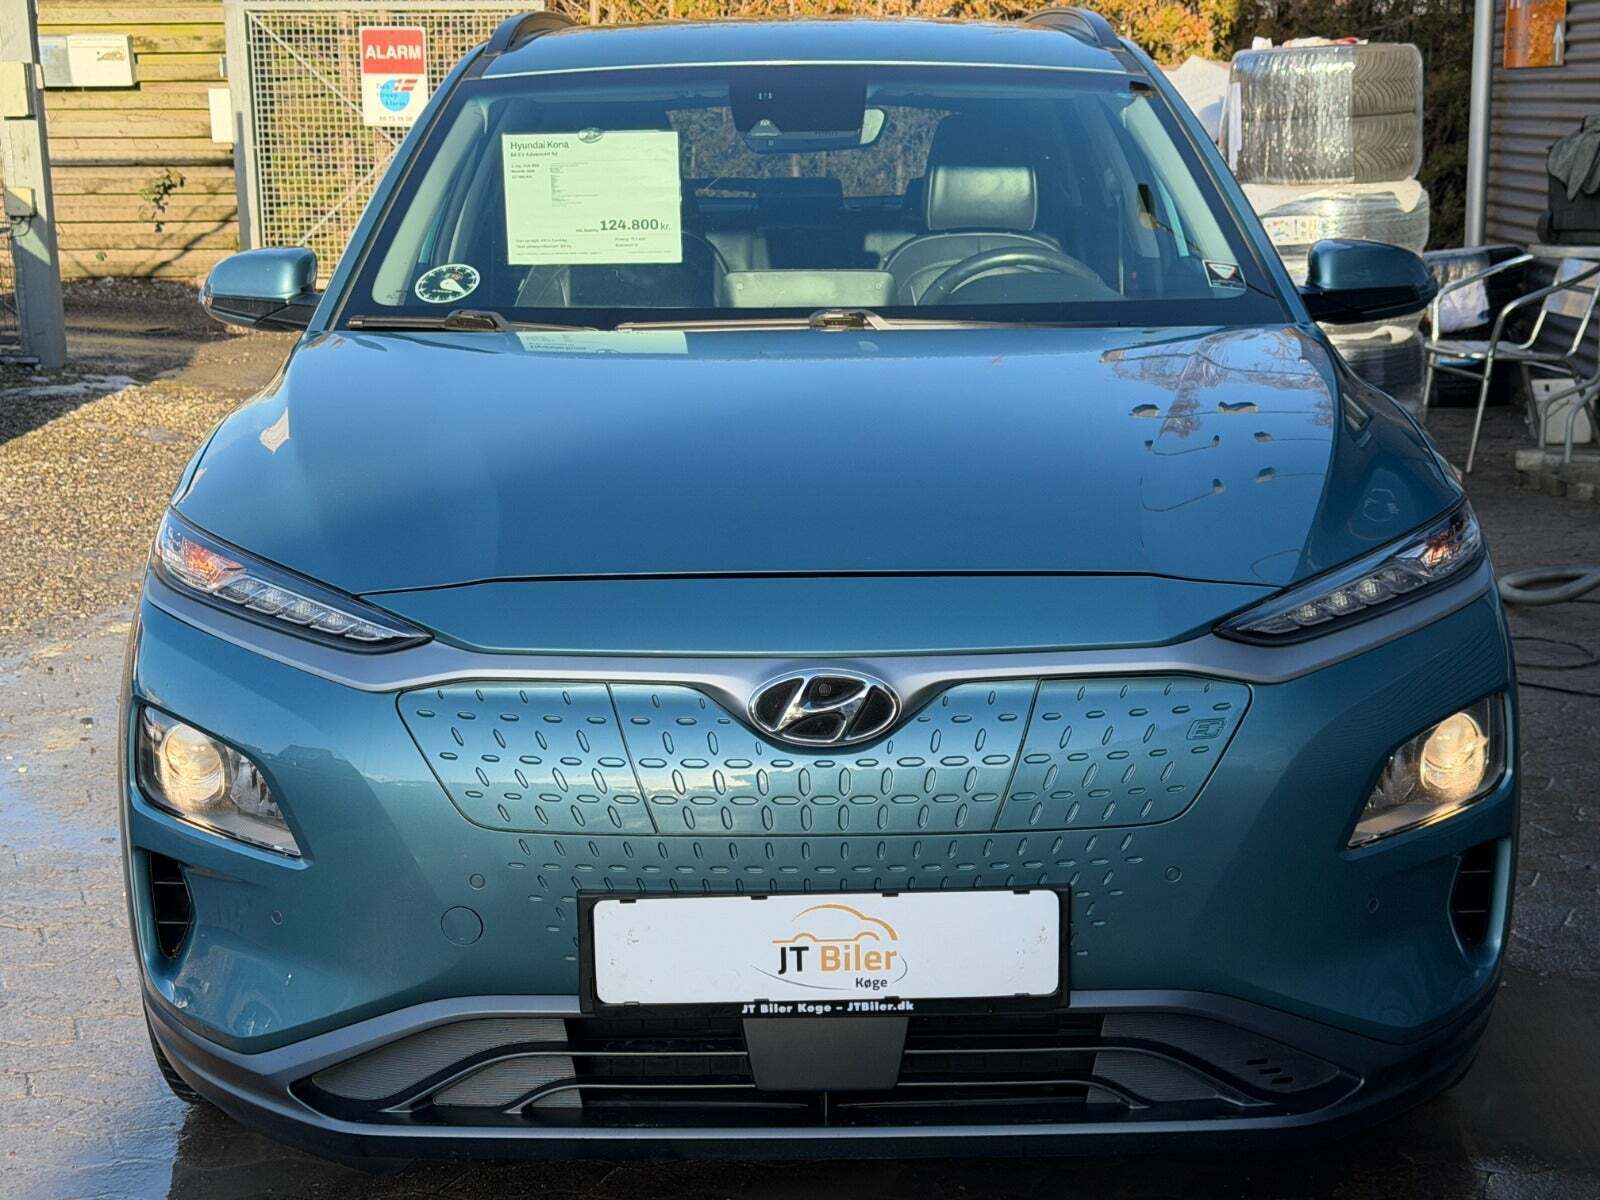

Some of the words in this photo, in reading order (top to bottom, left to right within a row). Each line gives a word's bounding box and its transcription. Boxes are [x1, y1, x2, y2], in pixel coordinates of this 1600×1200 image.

[365, 45, 421, 60] ALARM
[510, 141, 546, 151] Hyundai
[546, 140, 570, 149] Kona
[600, 218, 659, 231] 124.800
[660, 222, 672, 231] kr.
[778, 945, 809, 975] JT
[820, 944, 897, 972] Biler
[855, 977, 888, 991] Køge
[741, 1004, 756, 1014] JT
[760, 1003, 793, 1014] Biler
[847, 1000, 915, 1012] JTBiler.dk
